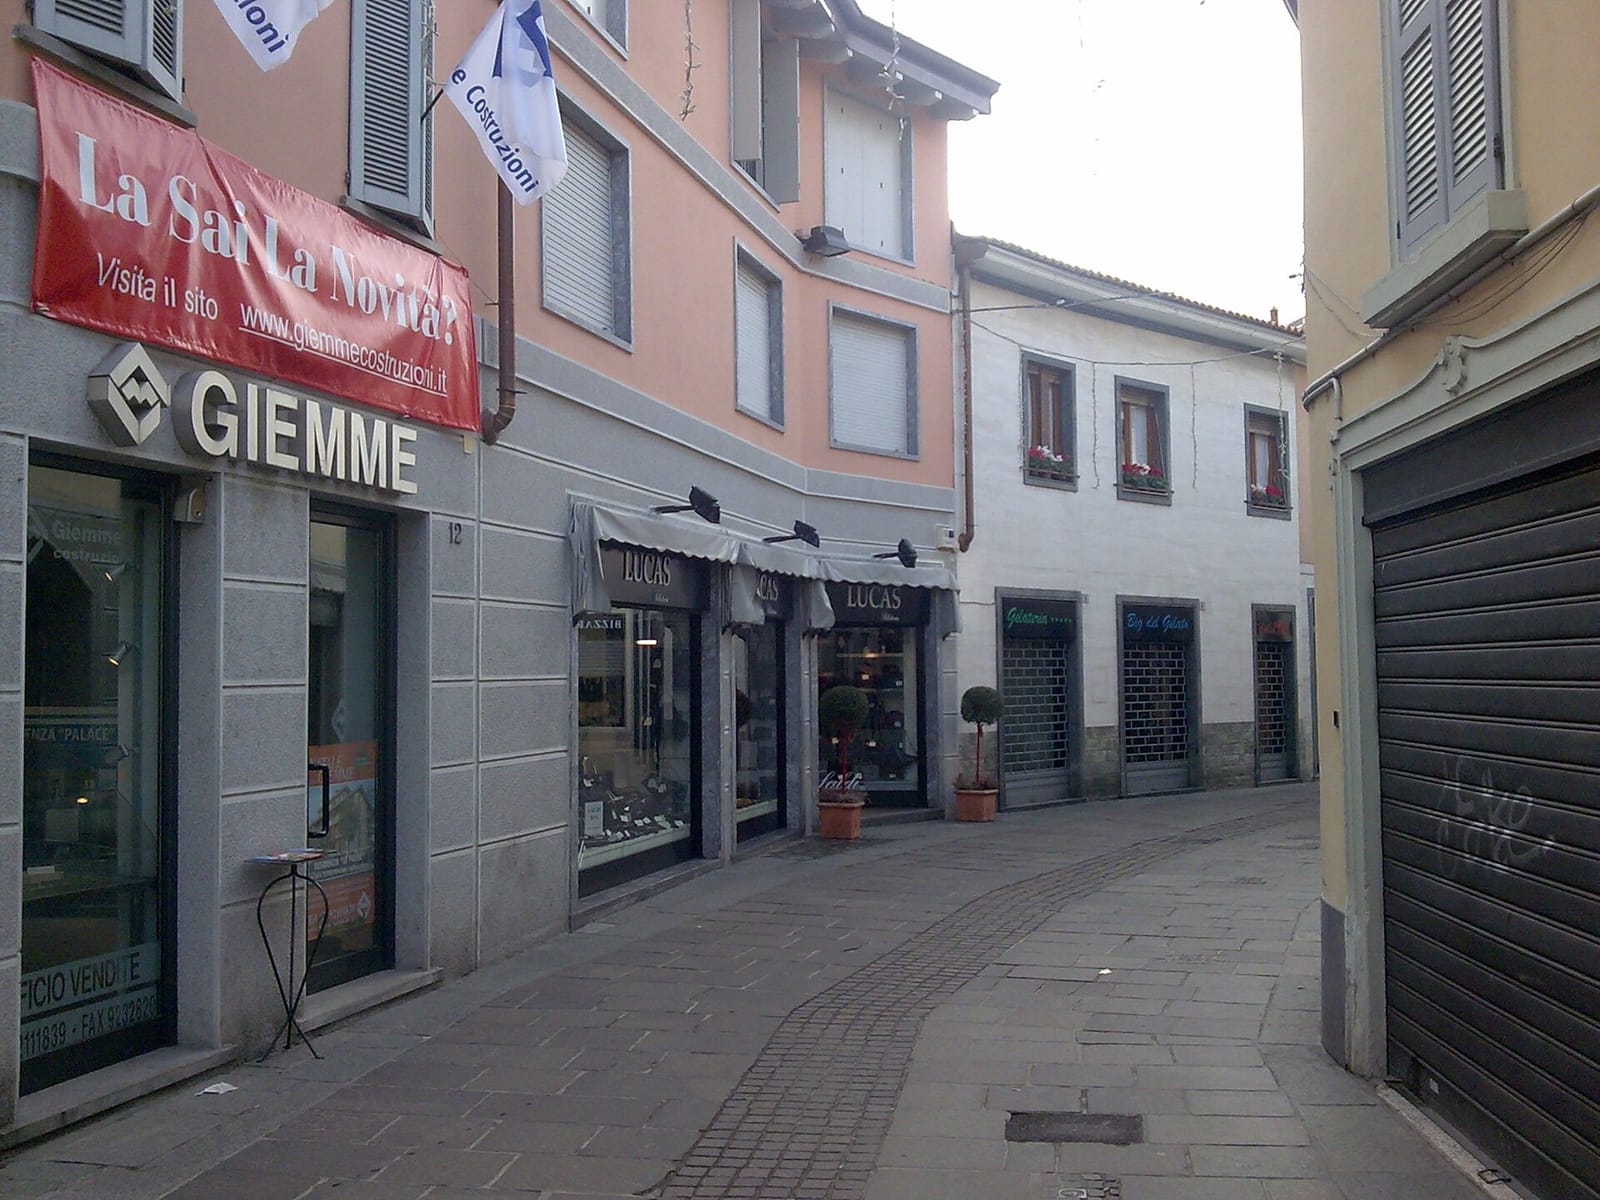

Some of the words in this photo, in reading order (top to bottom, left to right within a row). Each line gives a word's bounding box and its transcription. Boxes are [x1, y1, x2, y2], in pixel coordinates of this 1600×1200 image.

[451, 68, 467, 85] e
[466, 85, 540, 193] Costruzioni
[76, 131, 151, 227] La
[169, 174, 250, 266] Sai
[264, 214, 318, 293] La
[329, 244, 457, 345] Novità?
[97, 251, 156, 303] Visita
[164, 276, 176, 308] il
[184, 285, 218, 321] sito
[238, 303, 448, 394] www.giemmecostruzioni.it
[191, 370, 418, 495] GIEMME
[448, 521, 462, 545] 12
[623, 551, 672, 587] LUCAS
[757, 573, 778, 602] CAS
[847, 585, 902, 609] LUCAS
[69, 952, 141, 996] VENDITE
[81, 1008, 105, 1038] FAX
